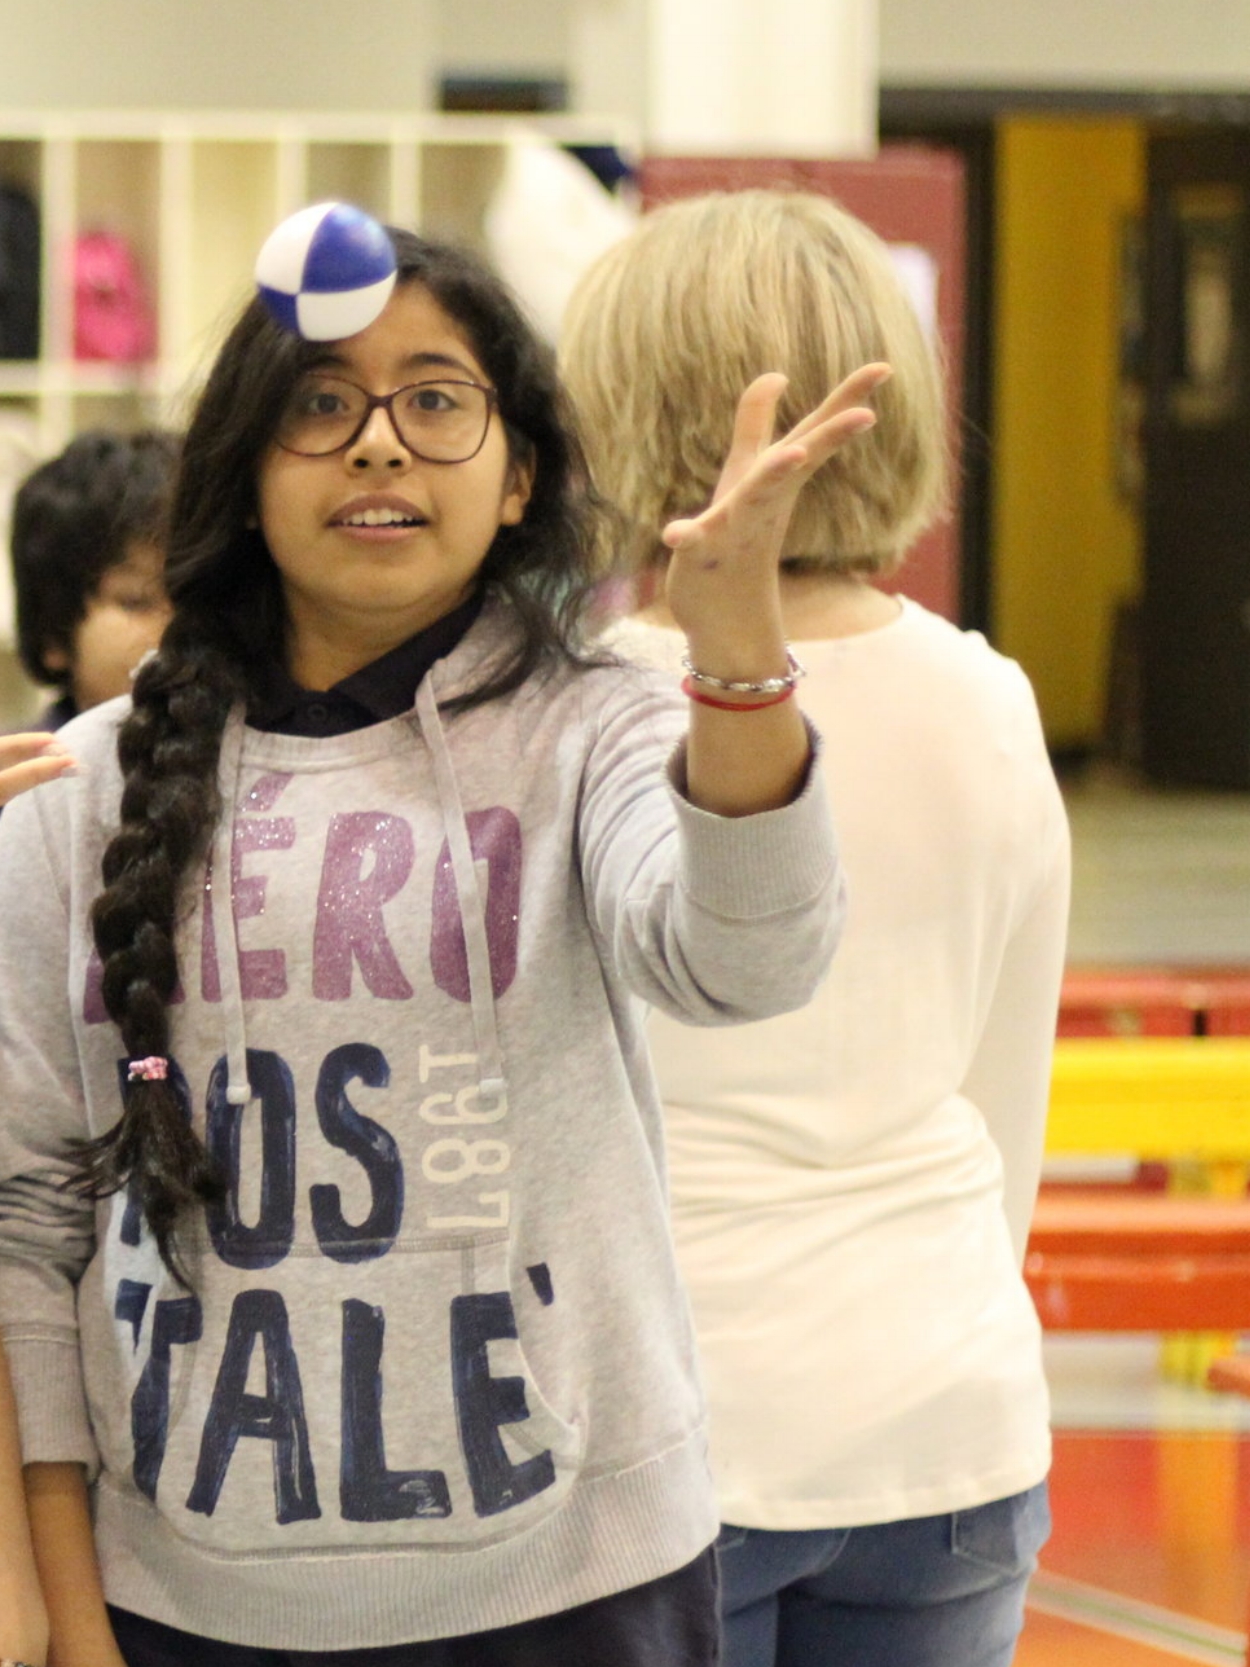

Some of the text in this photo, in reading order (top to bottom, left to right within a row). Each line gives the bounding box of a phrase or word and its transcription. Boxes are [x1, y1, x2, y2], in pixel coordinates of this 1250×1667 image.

[84, 773, 523, 1025] ÉRO
[117, 1042, 404, 1270] OS
[418, 1044, 511, 1229] 1987
